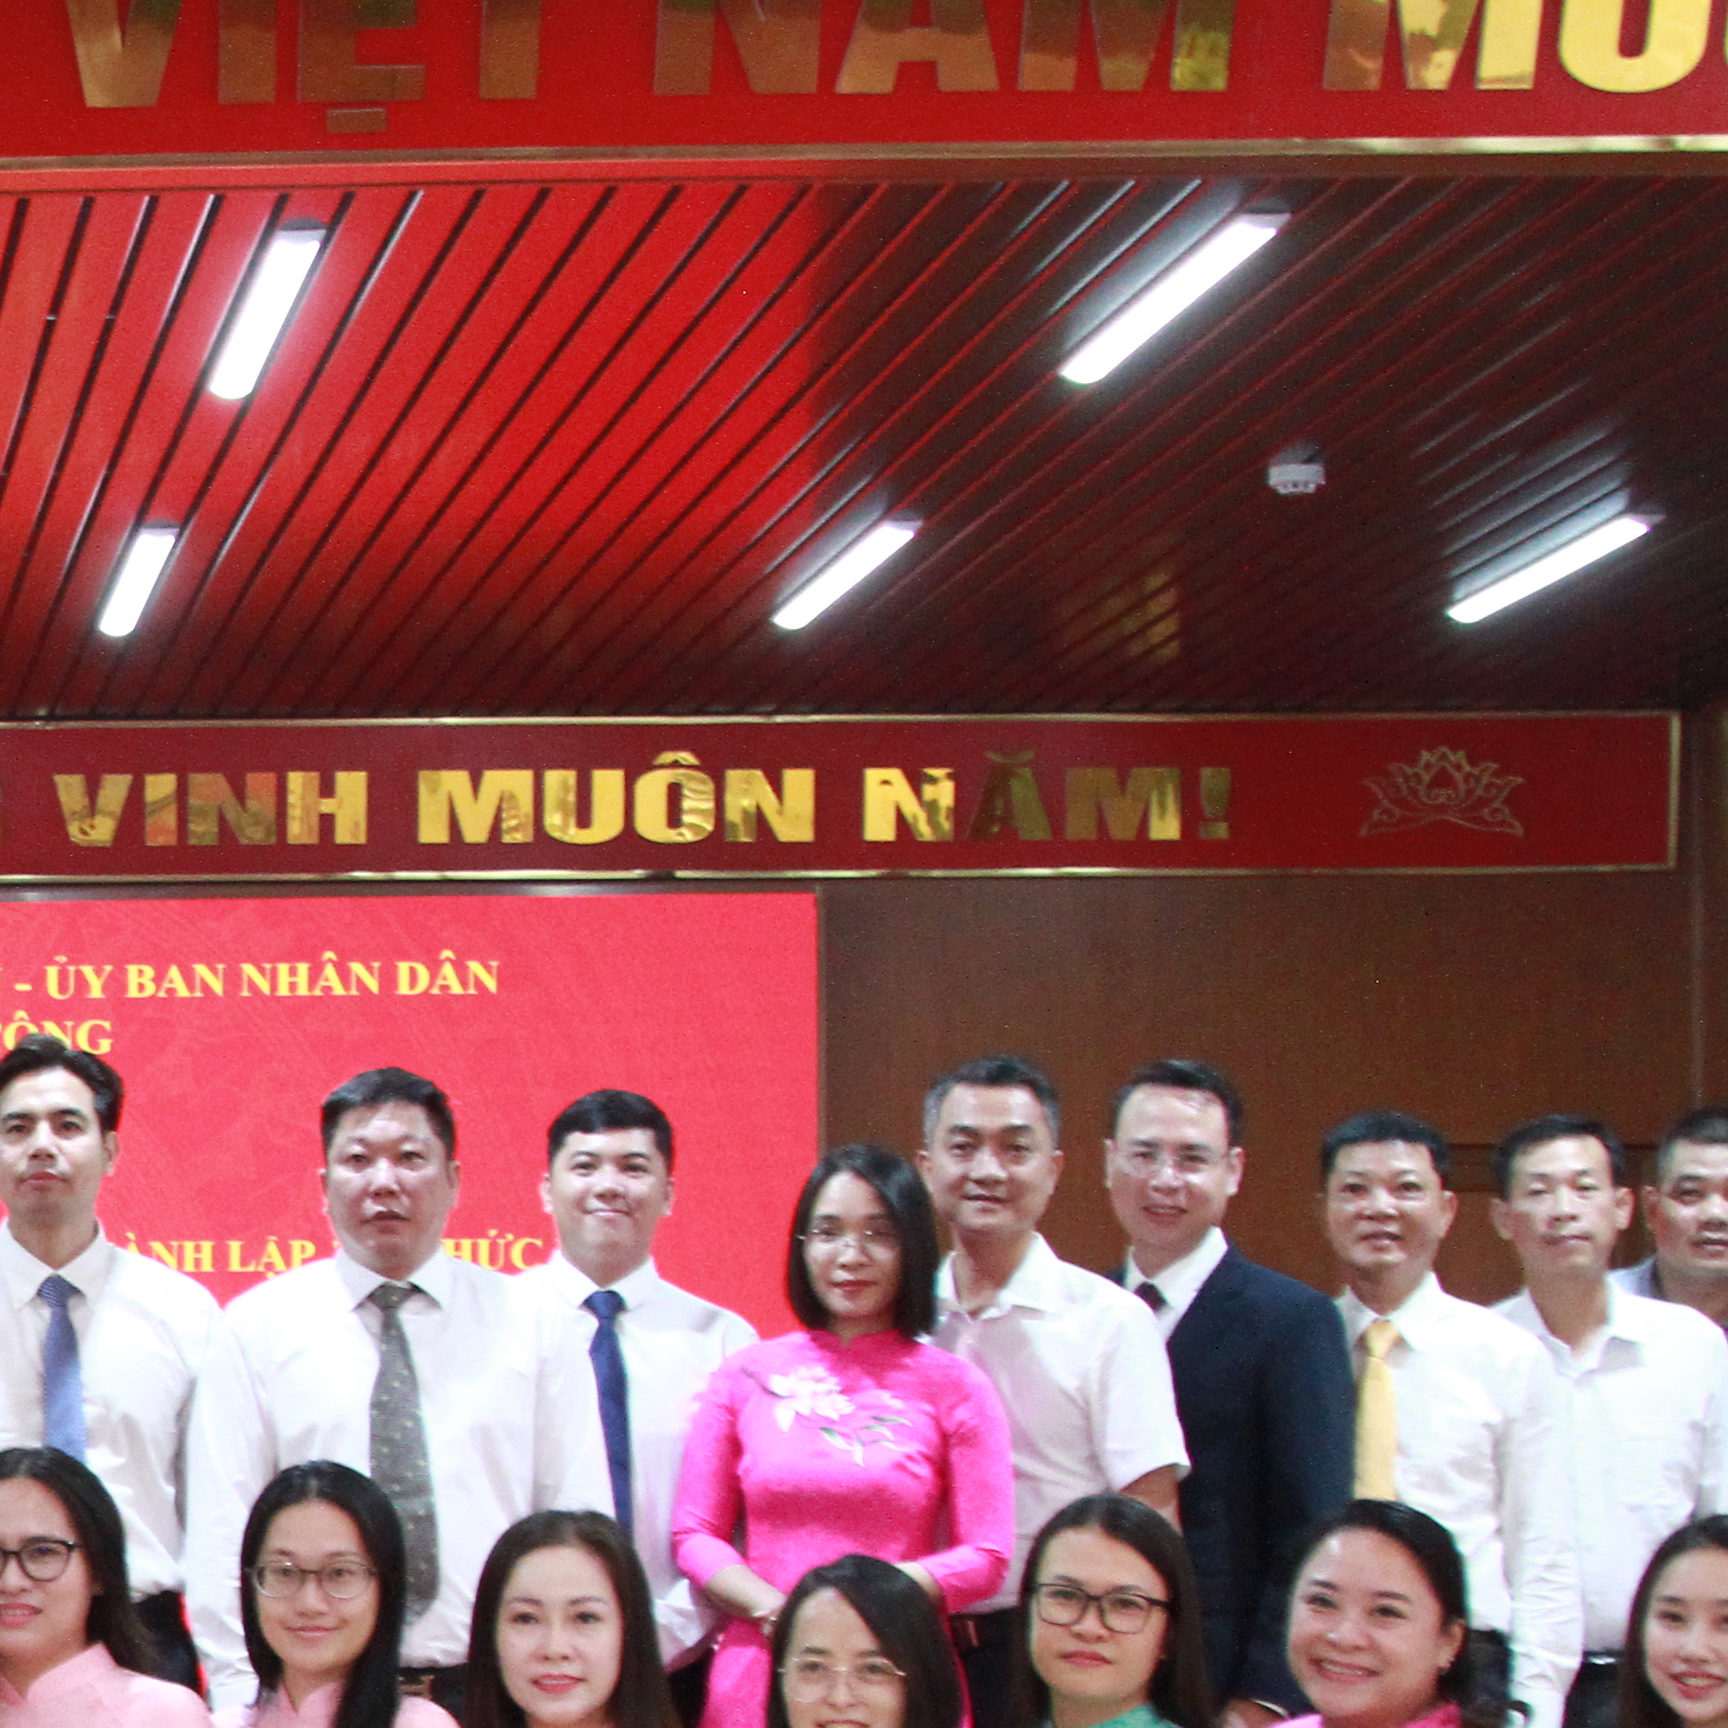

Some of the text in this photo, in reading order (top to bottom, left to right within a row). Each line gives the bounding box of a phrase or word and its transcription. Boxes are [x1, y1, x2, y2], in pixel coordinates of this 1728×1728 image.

[53, 770, 369, 849] VINH
[416, 750, 817, 846] MUÔN
[862, 750, 1232, 842] NĂM!
[43, 955, 114, 1000] ỦY
[124, 963, 226, 998] BAN
[238, 951, 381, 997] NHÂN
[393, 949, 500, 996] DÂN
[225, 1235, 317, 1280] LẬP
[440, 1229, 544, 1271] HỨC
